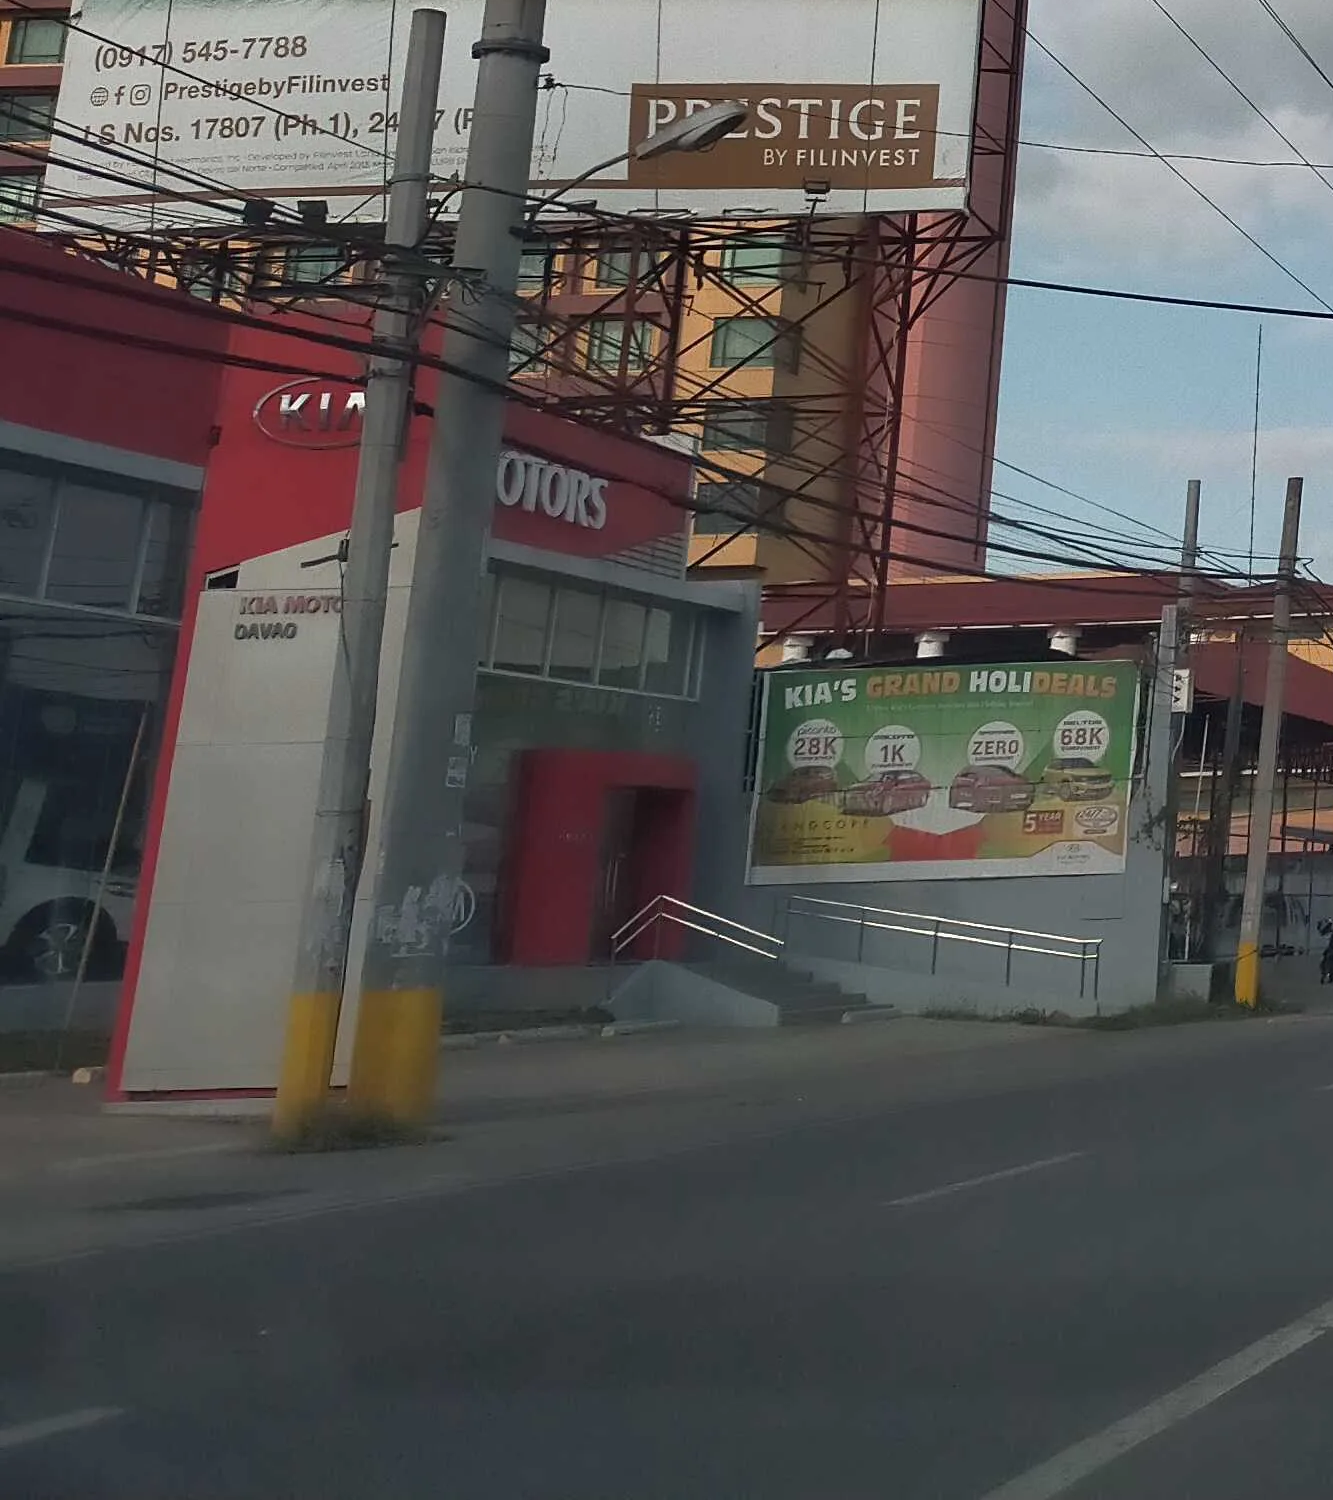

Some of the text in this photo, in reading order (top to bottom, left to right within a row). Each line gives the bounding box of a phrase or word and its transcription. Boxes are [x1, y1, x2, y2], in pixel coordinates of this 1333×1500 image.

[94, 35, 308, 72] (0917) 545-7788
[163, 73, 390, 101] PrestigebyFilinvest
[123, 121, 180, 144] Nos.
[191, 116, 266, 140] 17807
[367, 108, 446, 135] 247
[764, 149, 920, 166] BY FILINVEST
[279, 392, 366, 431] KIA
[496, 450, 608, 530] OTORS
[239, 595, 341, 615] KIA MOTO
[234, 622, 298, 640] DAVAO
[784, 670, 1117, 710] KIA'S GRAND HOLIDEALS
[793, 736, 838, 756] 28K
[972, 739, 1019, 756] ZERO
[1060, 728, 1104, 746] 68K
[880, 744, 905, 763] 1K
[1024, 813, 1037, 833] 5
[1039, 811, 1062, 822] YEAR
